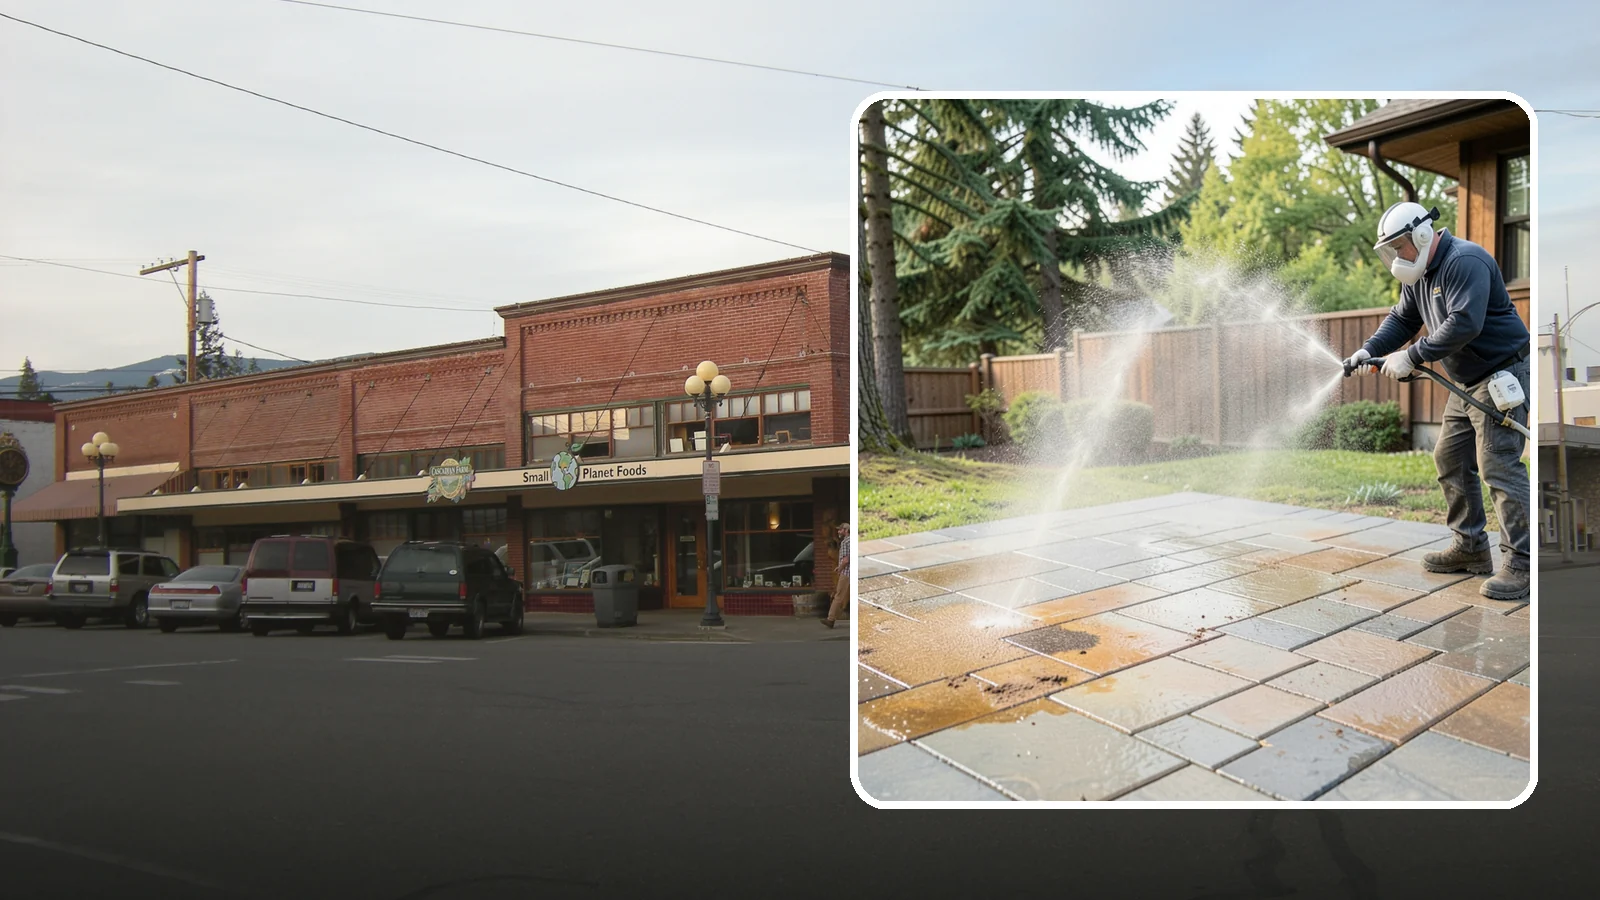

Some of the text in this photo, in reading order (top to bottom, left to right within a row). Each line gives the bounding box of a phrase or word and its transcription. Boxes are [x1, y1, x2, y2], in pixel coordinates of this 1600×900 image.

[523, 464, 647, 483] Small Planet Foods
